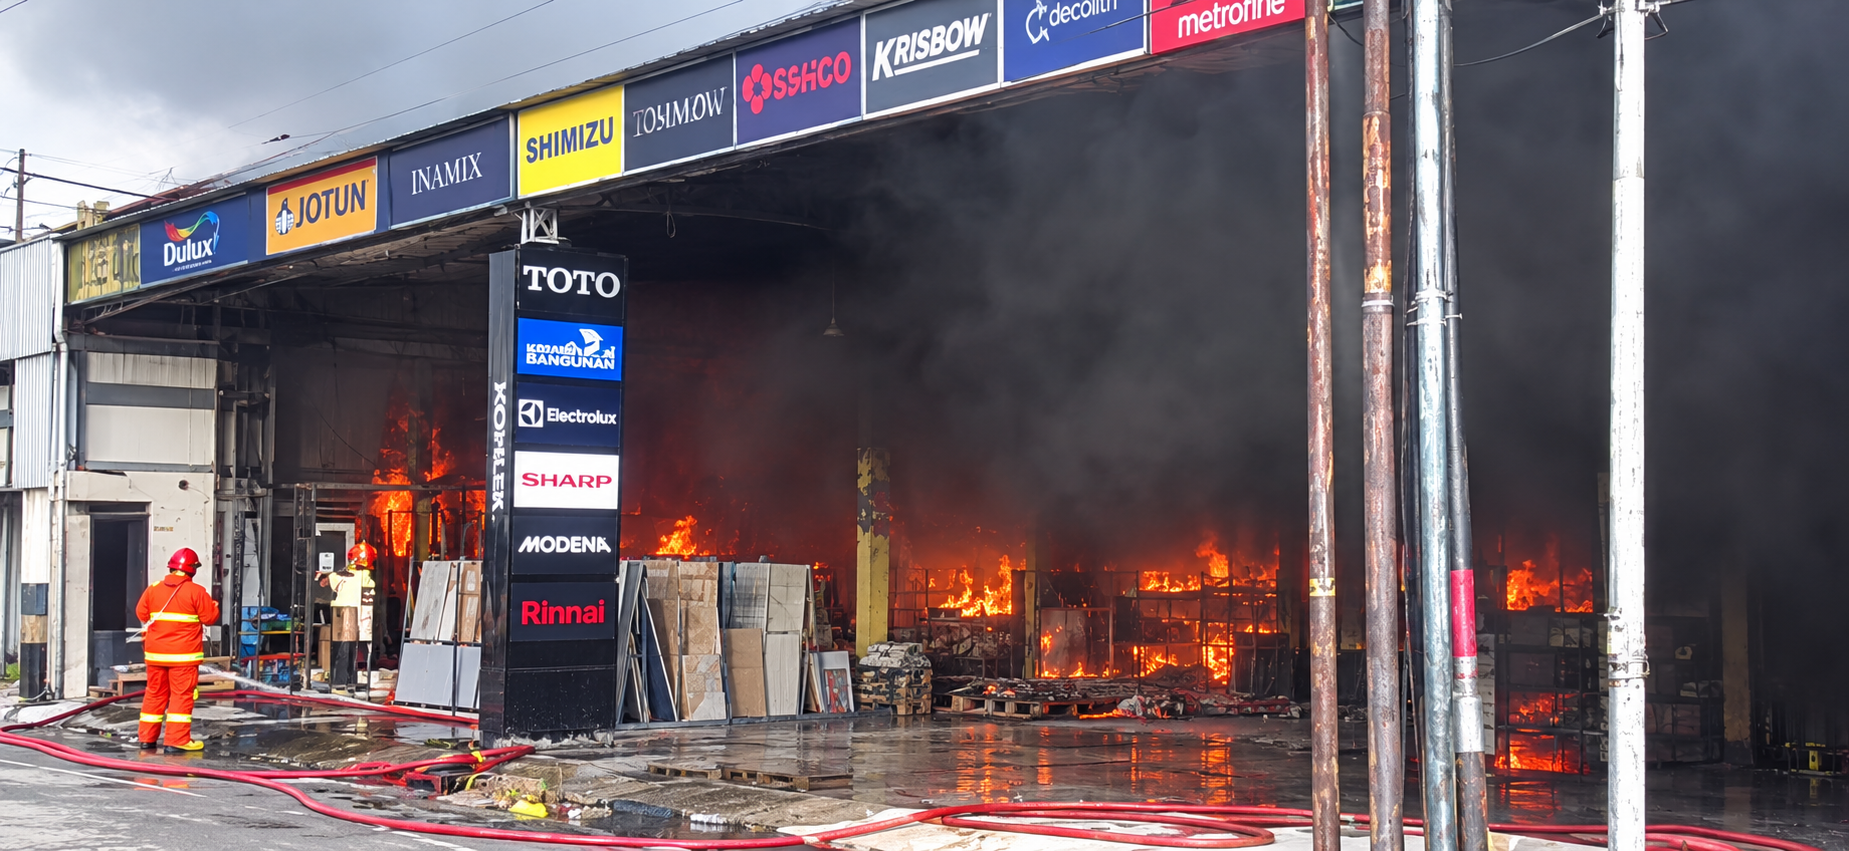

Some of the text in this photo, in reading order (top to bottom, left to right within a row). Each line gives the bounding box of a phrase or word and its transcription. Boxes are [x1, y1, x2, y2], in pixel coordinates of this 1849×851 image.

[1178, 0, 1285, 39] metrofine
[872, 13, 989, 81] KRISBOW
[526, 116, 614, 164] SHIMIZU
[411, 152, 483, 195] INAMIX
[296, 180, 366, 228] JOTUN
[164, 238, 213, 267] Dulux
[523, 265, 621, 298] TOTO
[526, 352, 615, 370] BANGUNAN
[547, 408, 617, 425] Electrolux
[521, 472, 612, 489] SHARP
[518, 535, 612, 553] MODENA
[521, 599, 605, 625] Rinnai
